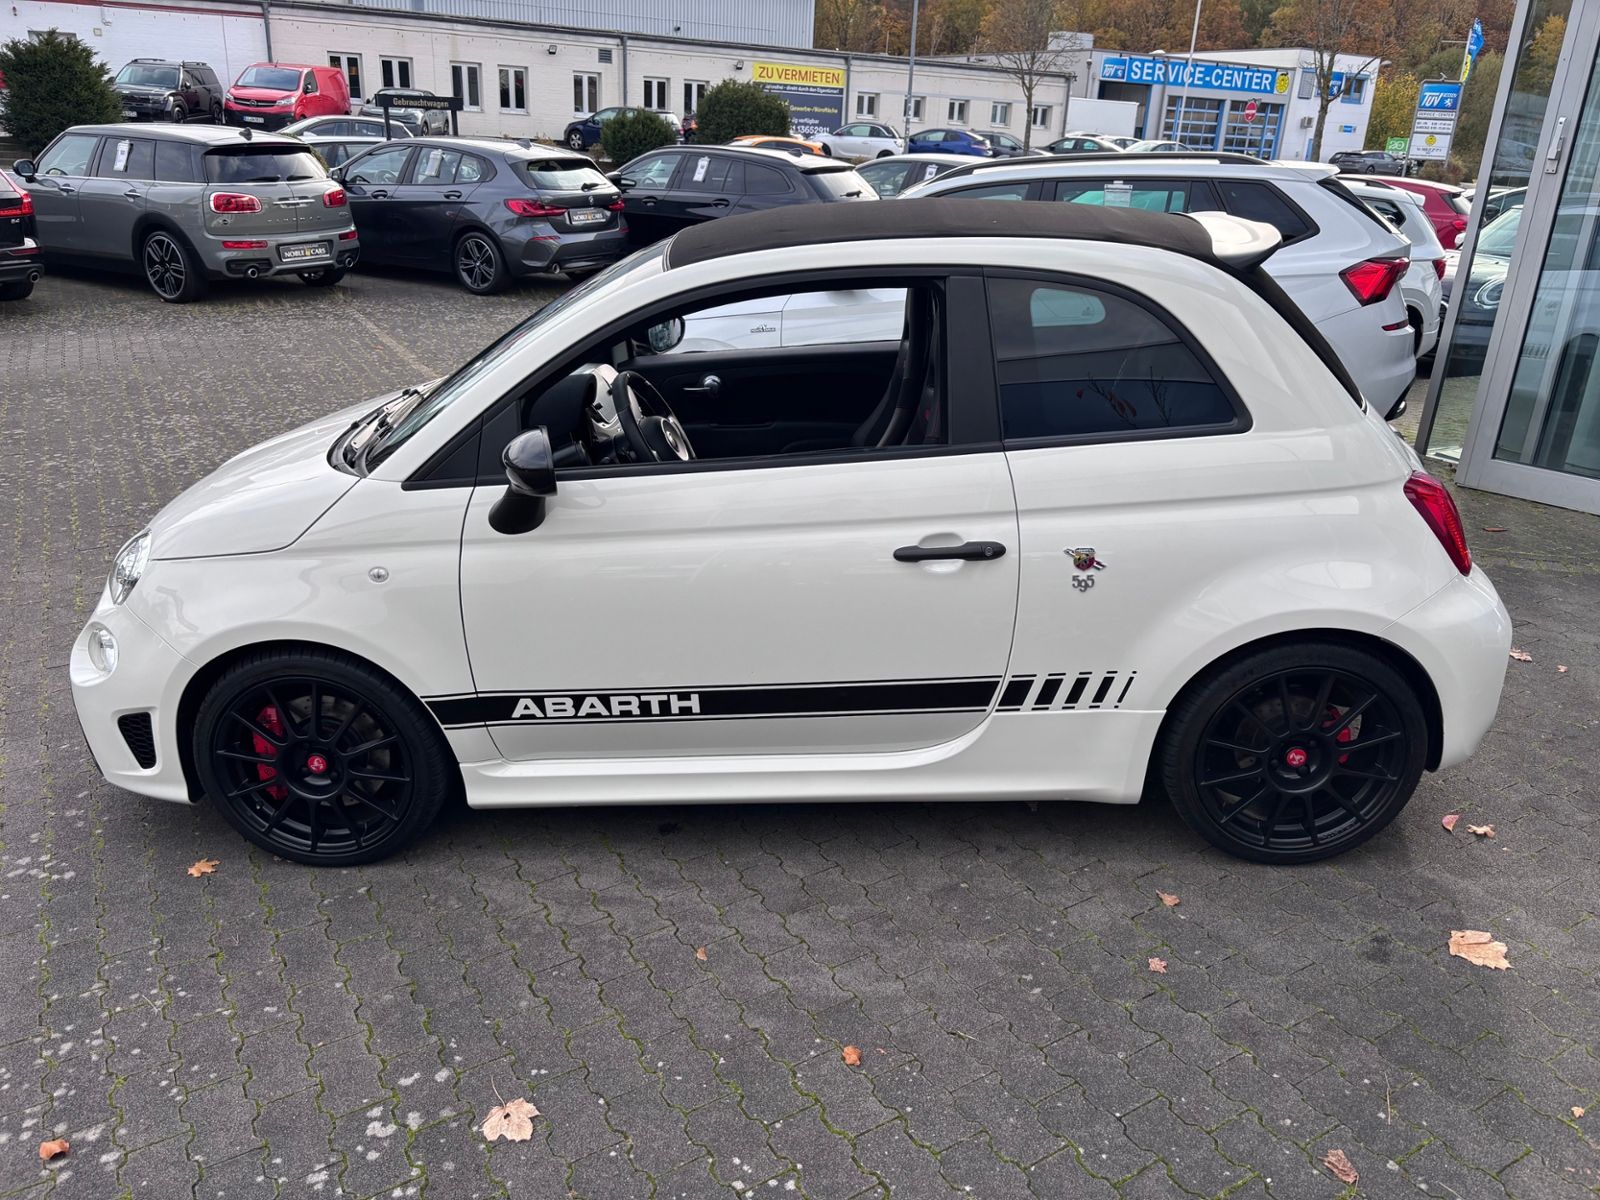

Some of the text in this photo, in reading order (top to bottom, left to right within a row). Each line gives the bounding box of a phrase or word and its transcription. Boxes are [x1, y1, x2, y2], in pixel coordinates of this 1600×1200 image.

[758, 66, 840, 84] ZU VERMIETEN
[1130, 61, 1272, 91] SERVICE-CENTER
[392, 97, 449, 108] Gebrauchtwagen
[284, 248, 305, 258] NOBLE
[310, 246, 326, 255] CARS
[1072, 574, 1095, 592] 595
[511, 693, 701, 718] ABARTH
